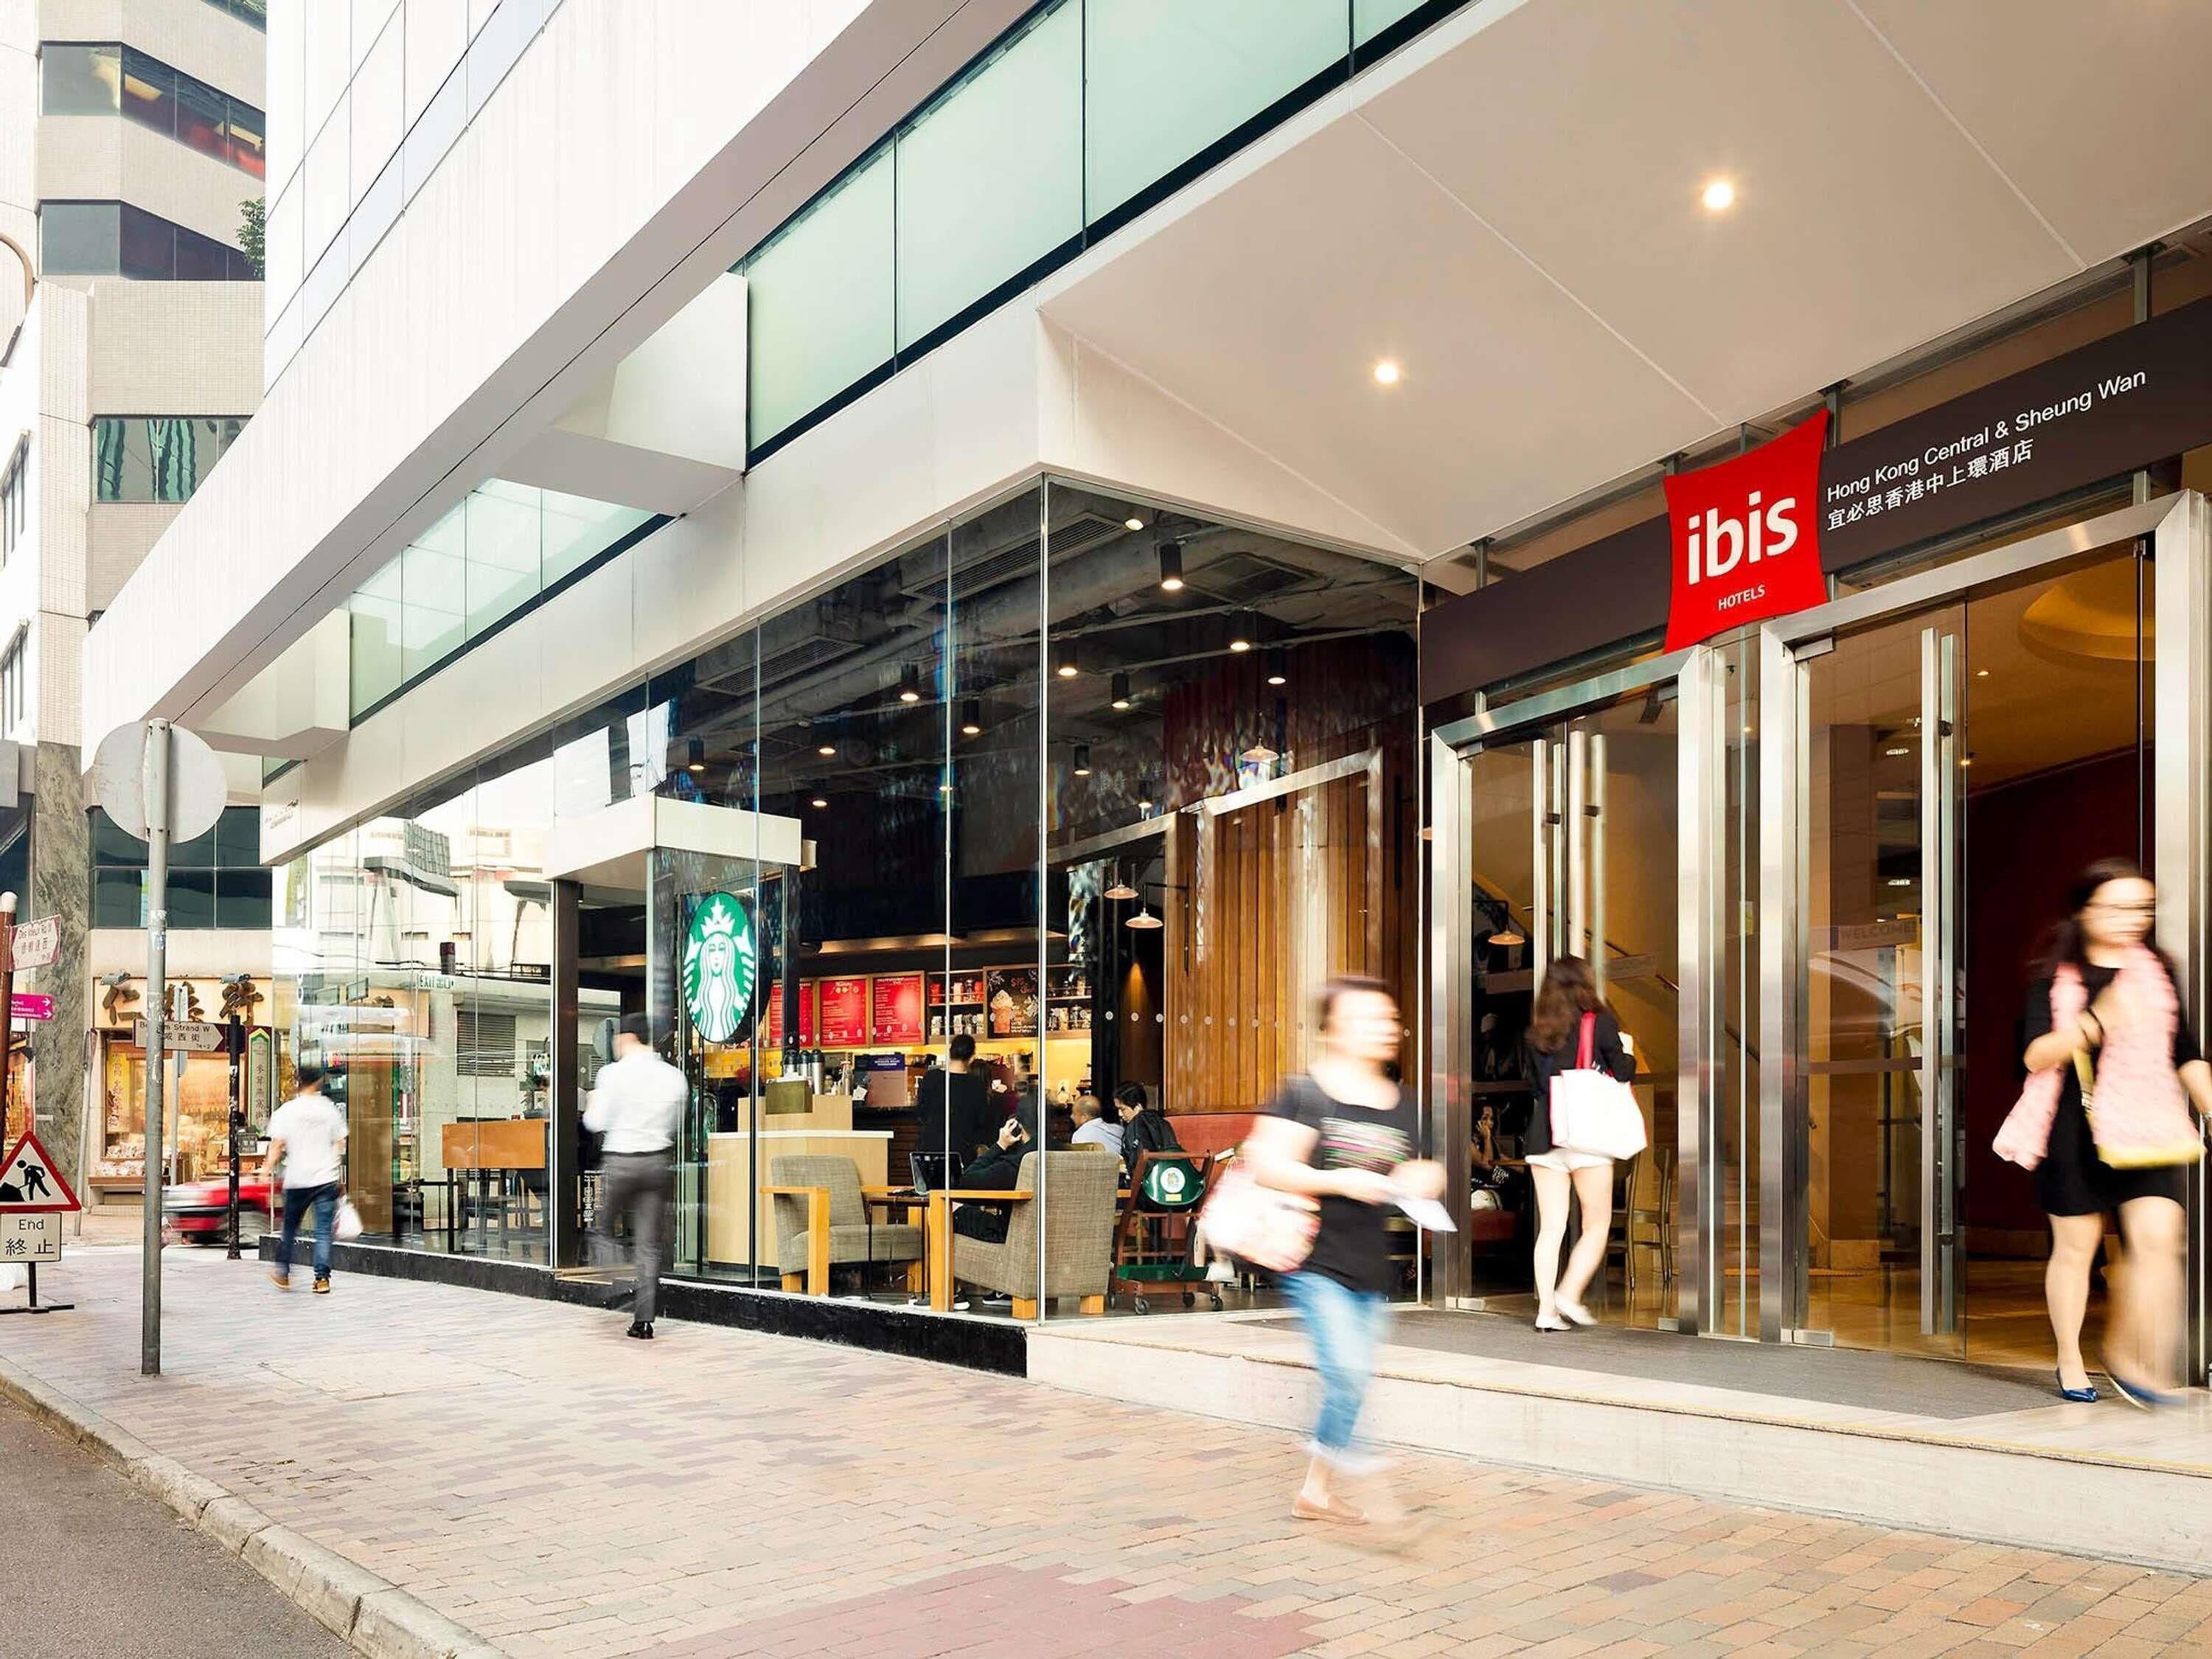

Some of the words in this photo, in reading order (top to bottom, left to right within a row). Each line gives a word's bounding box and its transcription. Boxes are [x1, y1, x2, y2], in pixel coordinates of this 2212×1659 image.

[1827, 476, 1870, 502] Hong
[1875, 458, 1919, 484] Kong
[1924, 427, 1989, 465] Central
[1995, 421, 2009, 438] &
[2015, 392, 2092, 431] Sheung
[2098, 372, 2146, 399] Wan
[1827, 439, 2034, 531] 宜必思香港中上環酒店
[1688, 490, 1798, 585] ibis
[1718, 585, 1765, 611] HOTELS
[174, 1023, 199, 1032] Strand
[18, 1219, 44, 1230] End
[5, 1238, 55, 1256] 終止
